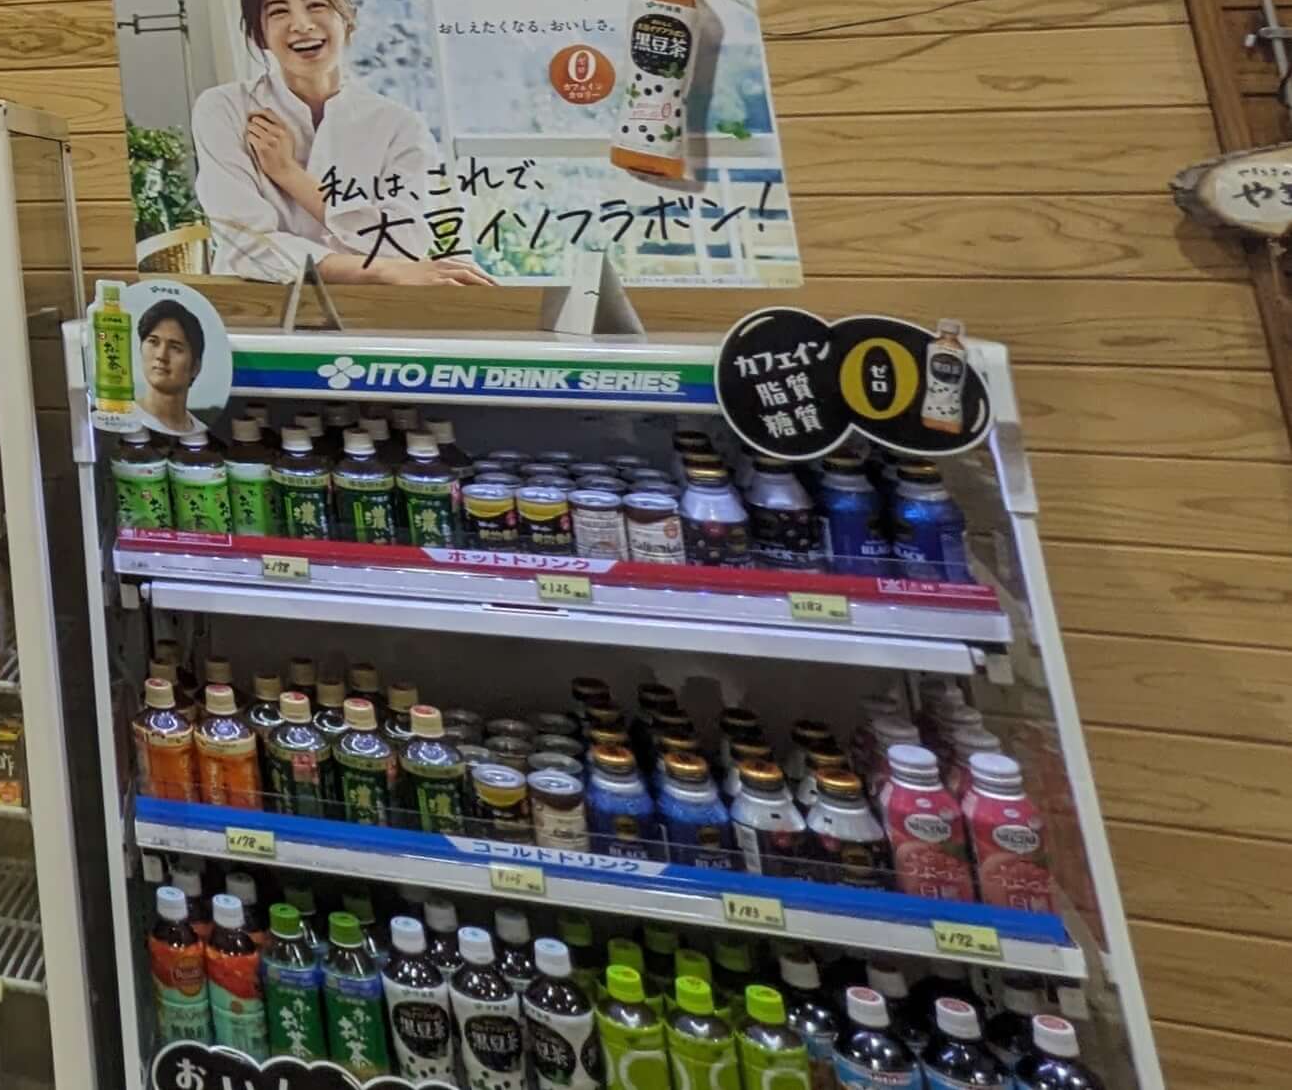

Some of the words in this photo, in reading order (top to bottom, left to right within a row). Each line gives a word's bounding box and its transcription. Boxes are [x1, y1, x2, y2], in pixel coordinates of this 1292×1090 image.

[438, 19, 616, 35] おしえたくなる、おいしさ。
[633, 31, 689, 59] 黒豆茶
[317, 157, 545, 208] 私は、これで、
[733, 340, 832, 380] カフェイン
[365, 363, 427, 388] ITO
[430, 365, 477, 389] EN
[483, 367, 571, 391] DRINK
[577, 370, 682, 393] SERIES
[755, 372, 816, 407] 脂質
[870, 365, 889, 394] ゼロ
[762, 405, 823, 439] 糖質
[448, 551, 591, 570] ホットドリンク
[471, 841, 641, 873] コールドドリンク
